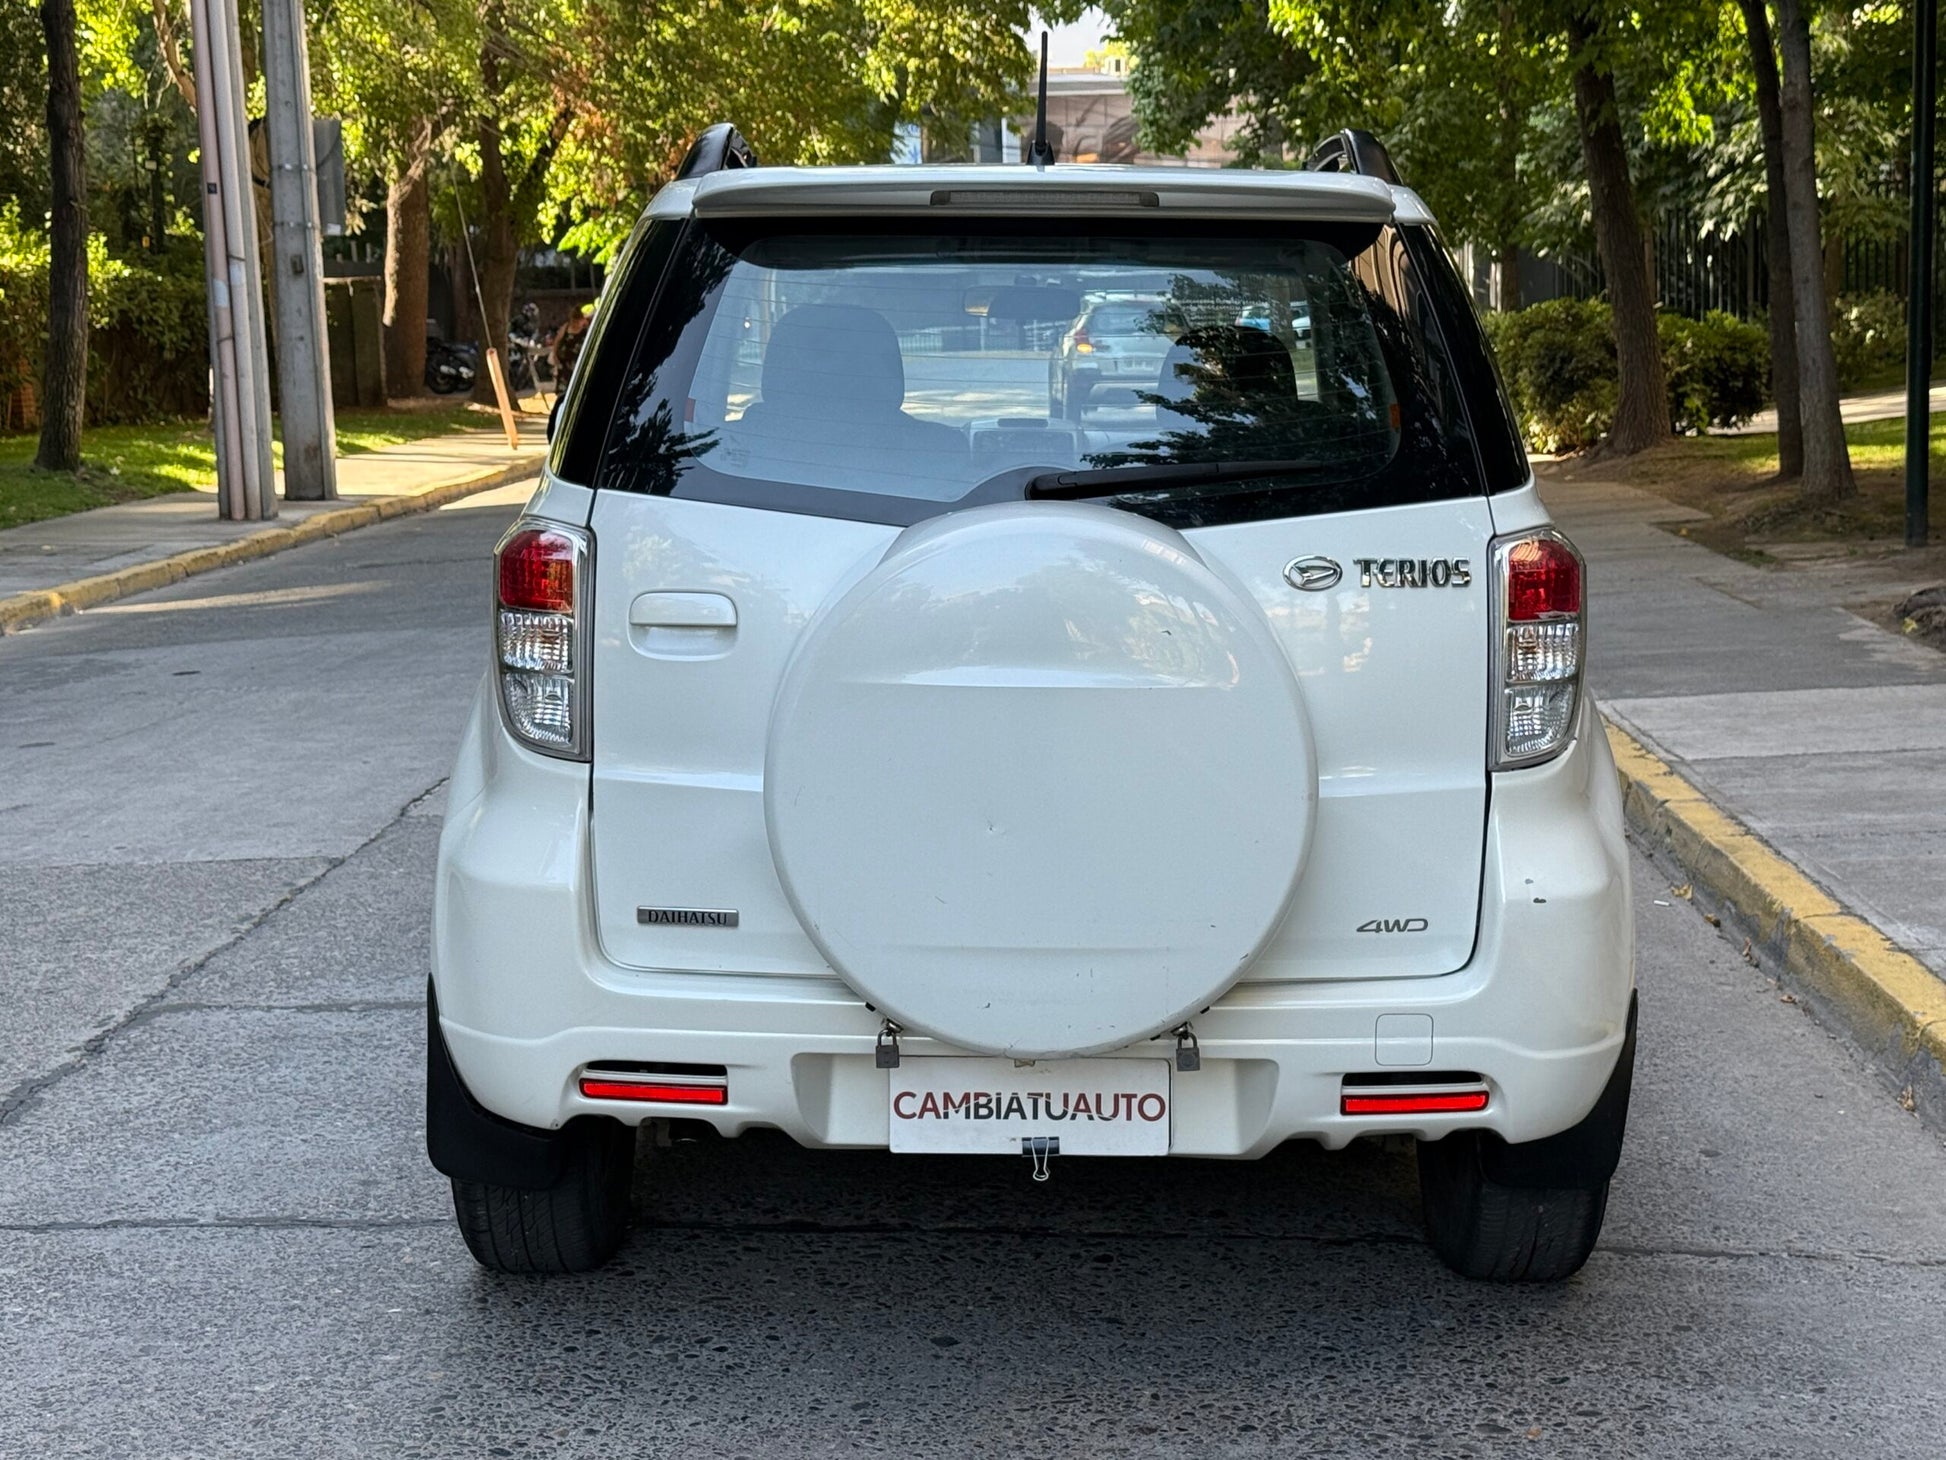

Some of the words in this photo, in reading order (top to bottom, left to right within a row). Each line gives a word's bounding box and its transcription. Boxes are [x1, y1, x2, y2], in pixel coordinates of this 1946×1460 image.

[1353, 557, 1471, 588] TERIOS
[648, 909, 728, 926] DAIHATSU
[1356, 918, 1429, 933] 4WD
[893, 1091, 1166, 1122] CAMBIATUAUTO
